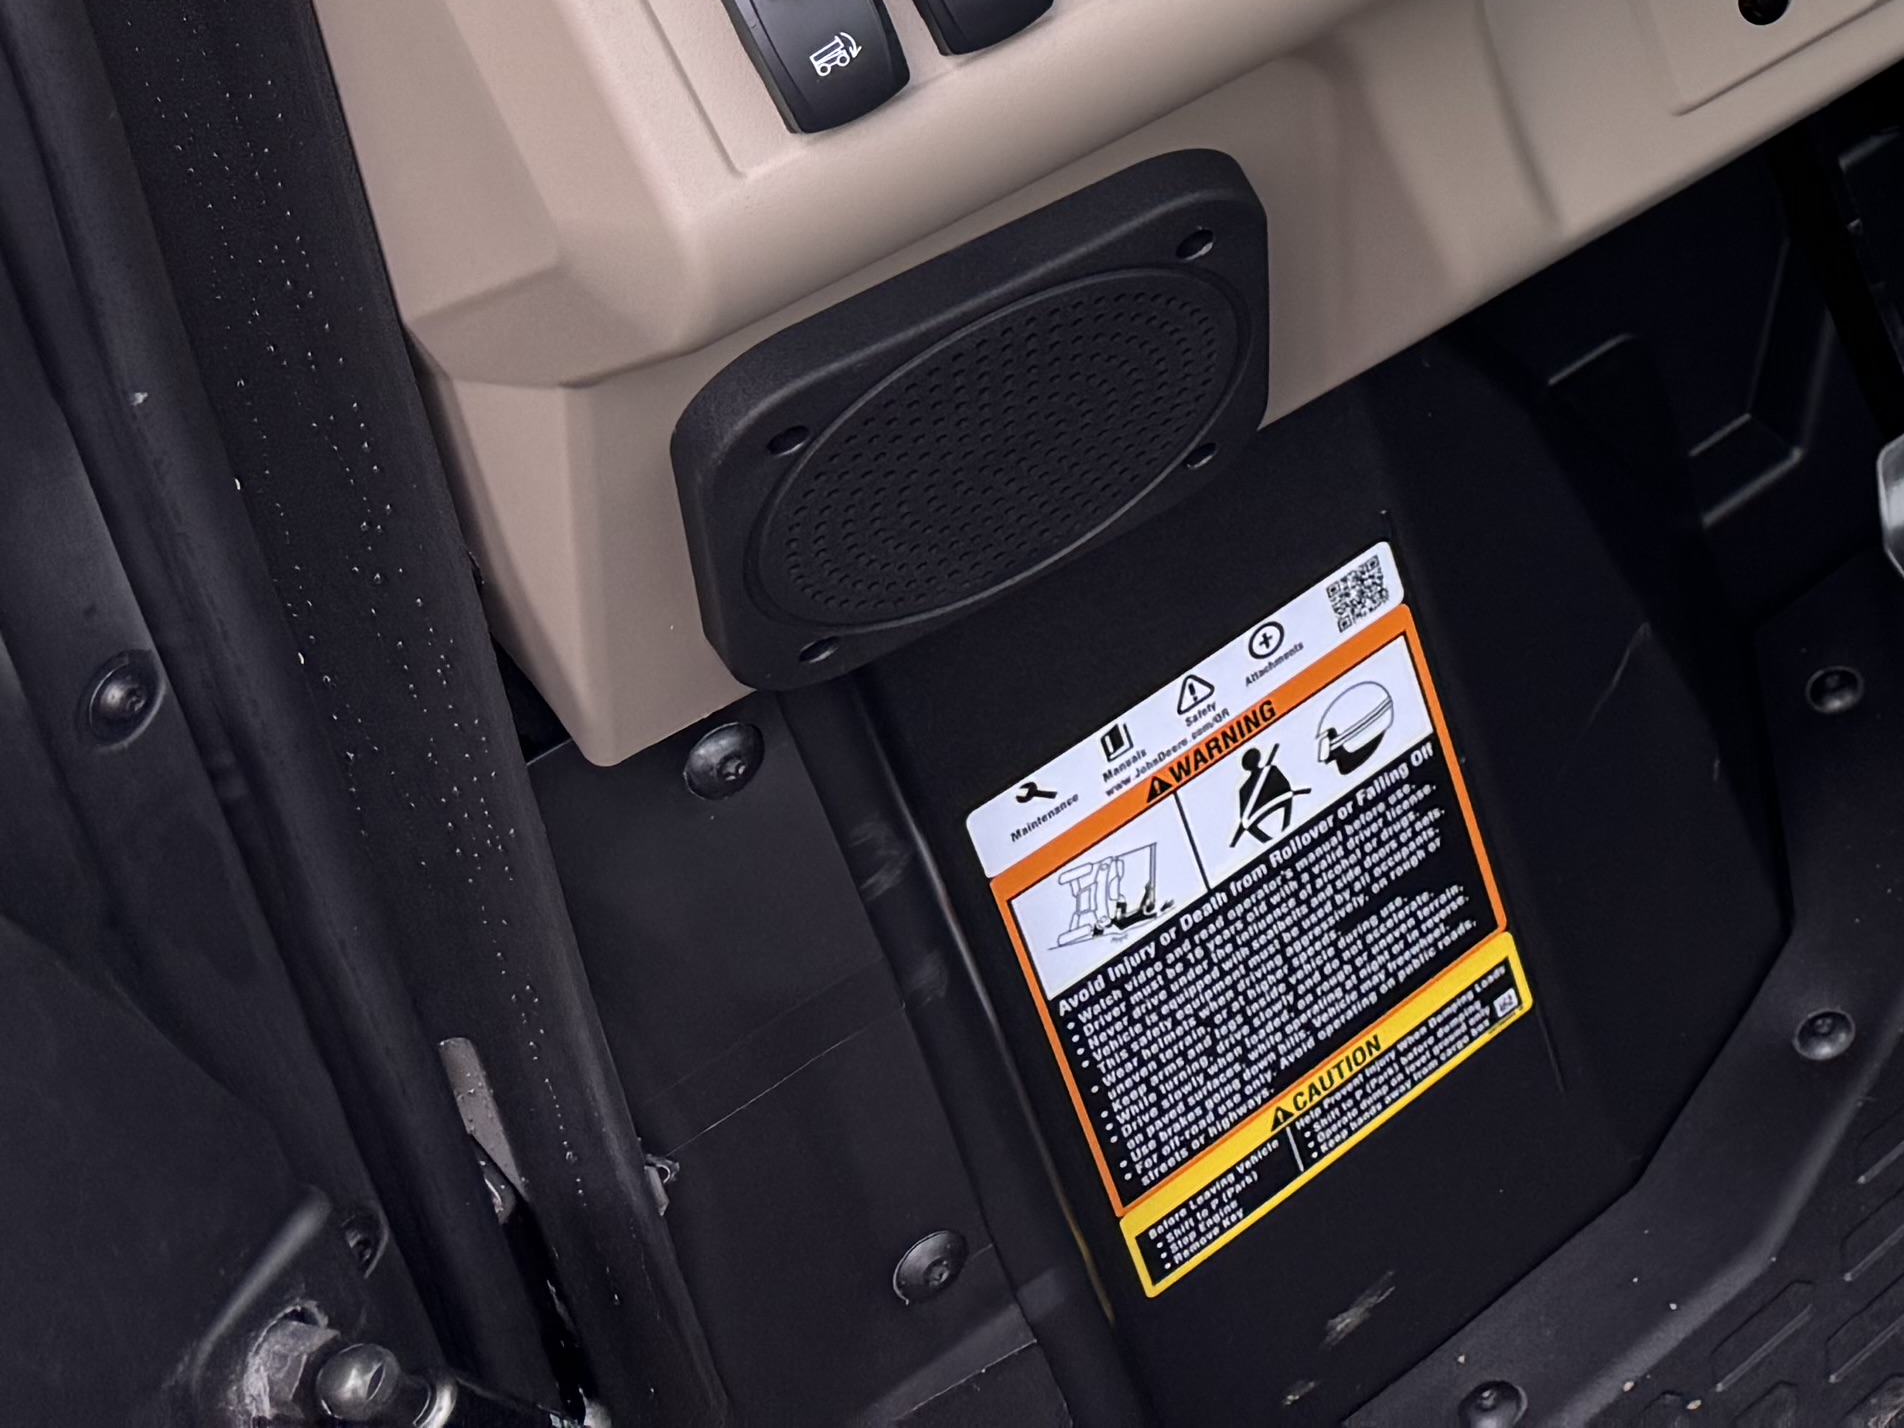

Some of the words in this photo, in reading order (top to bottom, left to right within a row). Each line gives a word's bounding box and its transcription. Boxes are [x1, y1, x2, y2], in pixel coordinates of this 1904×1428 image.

[1101, 748, 1148, 784] Manuals
[1167, 698, 1277, 789] WARNING
[1183, 700, 1217, 729] Safety
[1244, 641, 1305, 688] Attachments
[1009, 792, 1080, 844] Maintenance
[1058, 973, 1107, 1018] Avoid
[1106, 940, 1157, 983] Injury
[1158, 925, 1178, 947] or
[1178, 891, 1229, 933] Death
[1228, 862, 1269, 898] from
[1268, 813, 1335, 869] Rollover
[1336, 799, 1354, 821] or
[1354, 761, 1410, 807] Falling
[1409, 740, 1434, 768] Off
[1076, 988, 1124, 1024] Watch
[1123, 960, 1164, 993] video
[1164, 937, 1193, 966] and
[1192, 914, 1226, 946] read
[1226, 867, 1295, 922] operator's
[1294, 829, 1344, 873] manual
[1343, 800, 1387, 837] before
[1386, 782, 1417, 806] use.
[1081, 1000, 1127, 1038] Driver
[1128, 973, 1166, 1006] must
[1164, 961, 1185, 980] be
[1185, 944, 1206, 965] 16
[1204, 918, 1245, 953] years
[1245, 899, 1269, 924] old
[1268, 879, 1300, 906] with
[1299, 870, 1311, 885] a
[1310, 843, 1346, 876] valid
[1345, 816, 1384, 851] driver
[1384, 783, 1438, 823] license.
[1086, 1014, 1129, 1051] Never
[1131, 988, 1169, 1021] drive
[1169, 958, 1210, 994] under
[1209, 942, 1235, 964] the
[1234, 896, 1298, 947] influence
[1297, 882, 1314, 901] of
[1314, 847, 1363, 890] alcohol
[1362, 836, 1379, 854] or
[1379, 810, 1421, 843] drugs.
[1091, 1022, 1144, 1063] Vehicle
[1143, 1011, 1160, 1028] is
[1159, 964, 1221, 1016] equipped
[1220, 945, 1251, 972] with
[1250, 903, 1310, 952] seatbelts
[1309, 882, 1335, 909] and
[1334, 864, 1363, 891] side
[1362, 838, 1399, 870] doors
[1398, 826, 1414, 844] or
[1413, 807, 1446, 833] nets.
[1095, 1047, 1130, 1075] This
[1129, 1016, 1173, 1054] safety
[1174, 962, 1247, 1022] equipment
[1246, 937, 1282, 970] must
[1280, 925, 1301, 945] be
[1300, 898, 1334, 931] used
[1333, 887, 1352, 907] by
[1352, 871, 1372, 894] all
[1371, 826, 1441, 879] occupants.
[1100, 1055, 1139, 1088] Wear
[1140, 1011, 1198, 1061] helmets
[1197, 988, 1236, 1020] when
[1235, 953, 1284, 993] driving
[1284, 892, 1370, 958] aggressively,
[1370, 876, 1389, 895] on
[1388, 848, 1427, 882] rough
[1426, 836, 1442, 854] or
[1106, 1059, 1159, 1102] uneven
[1157, 1025, 1212, 1064] terrain,
[1212, 1007, 1229, 1026] or
[1230, 994, 1247, 1014] at
[1245, 963, 1290, 1001] higher
[1290, 928, 1343, 969] speeds.
[1110, 1082, 1148, 1114] Keep
[1148, 1055, 1186, 1088] arms
[1186, 1033, 1213, 1061] and
[1213, 1013, 1245, 1040] legs
[1244, 981, 1288, 1018] inside
[1287, 945, 1336, 986] vehicle
[1336, 914, 1380, 951] during
[1378, 895, 1409, 919] use.
[1114, 1091, 1159, 1125] While
[1157, 1054, 1215, 1096] turning,
[1215, 1023, 1251, 1056] drive
[1251, 990, 1295, 1029] slowly
[1296, 969, 1323, 996] and
[1322, 957, 1341, 976] do
[1340, 938, 1364, 963] not
[1364, 890, 1435, 945] accelerate.
[1291, 1033, 1382, 1113] CAUTION
